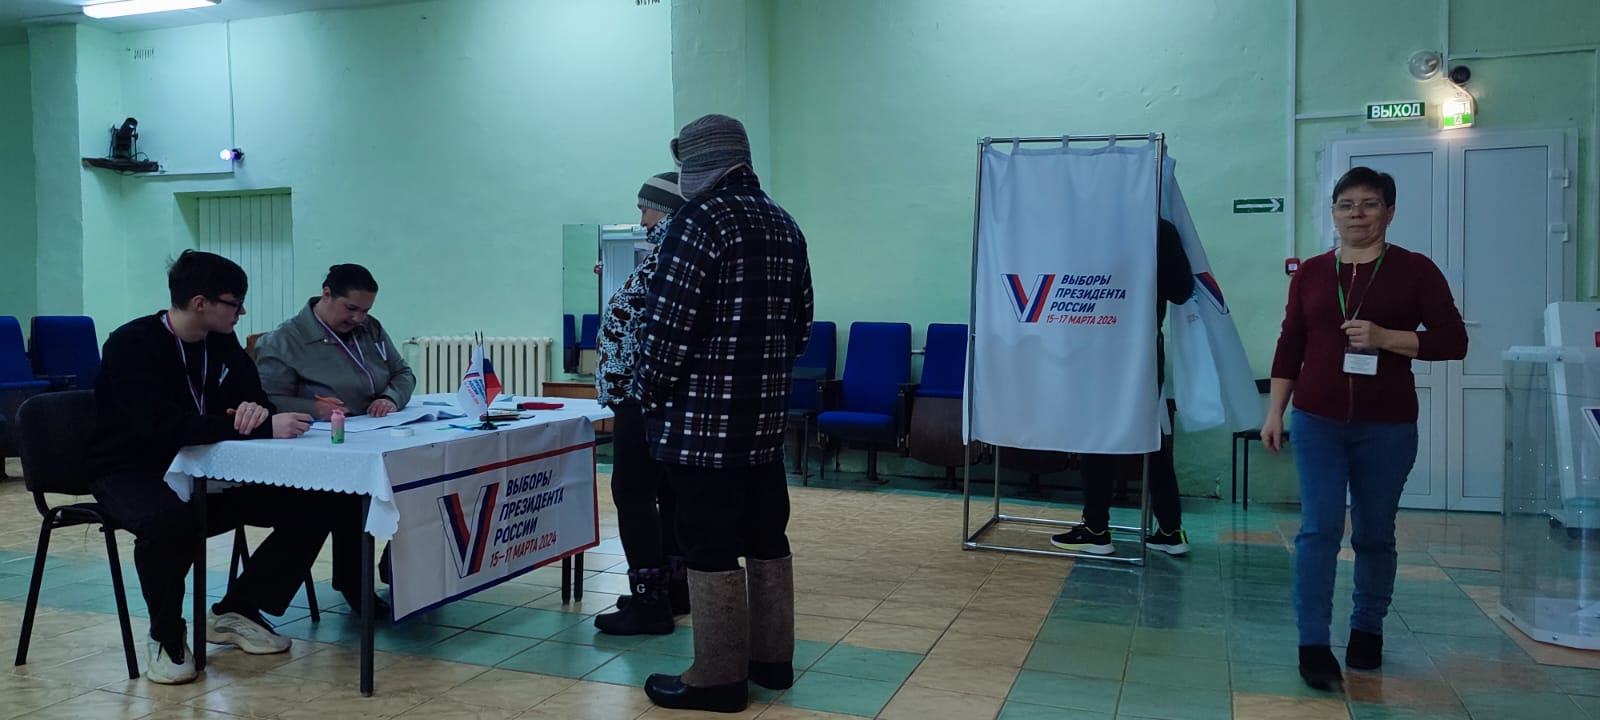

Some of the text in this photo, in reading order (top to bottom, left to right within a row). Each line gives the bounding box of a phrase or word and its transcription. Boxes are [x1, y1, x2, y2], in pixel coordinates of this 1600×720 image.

[1371, 103, 1421, 118] ВЫХОД
[1061, 274, 1112, 286] ВЫБОРЫ
[1055, 287, 1127, 301] ПРЕЗИДЕНТА
[1049, 301, 1097, 313] РОССИИ
[1068, 315, 1096, 325] МАРТА
[1096, 315, 1117, 325] 2024
[506, 470, 553, 497] ВЫБОРЫ
[499, 488, 564, 521] ПРЕЗИДЕНТА
[494, 517, 538, 546] РОССИИ
[512, 538, 539, 560] МАРТА
[539, 531, 557, 549] 2024
[636, 583, 646, 594] G
